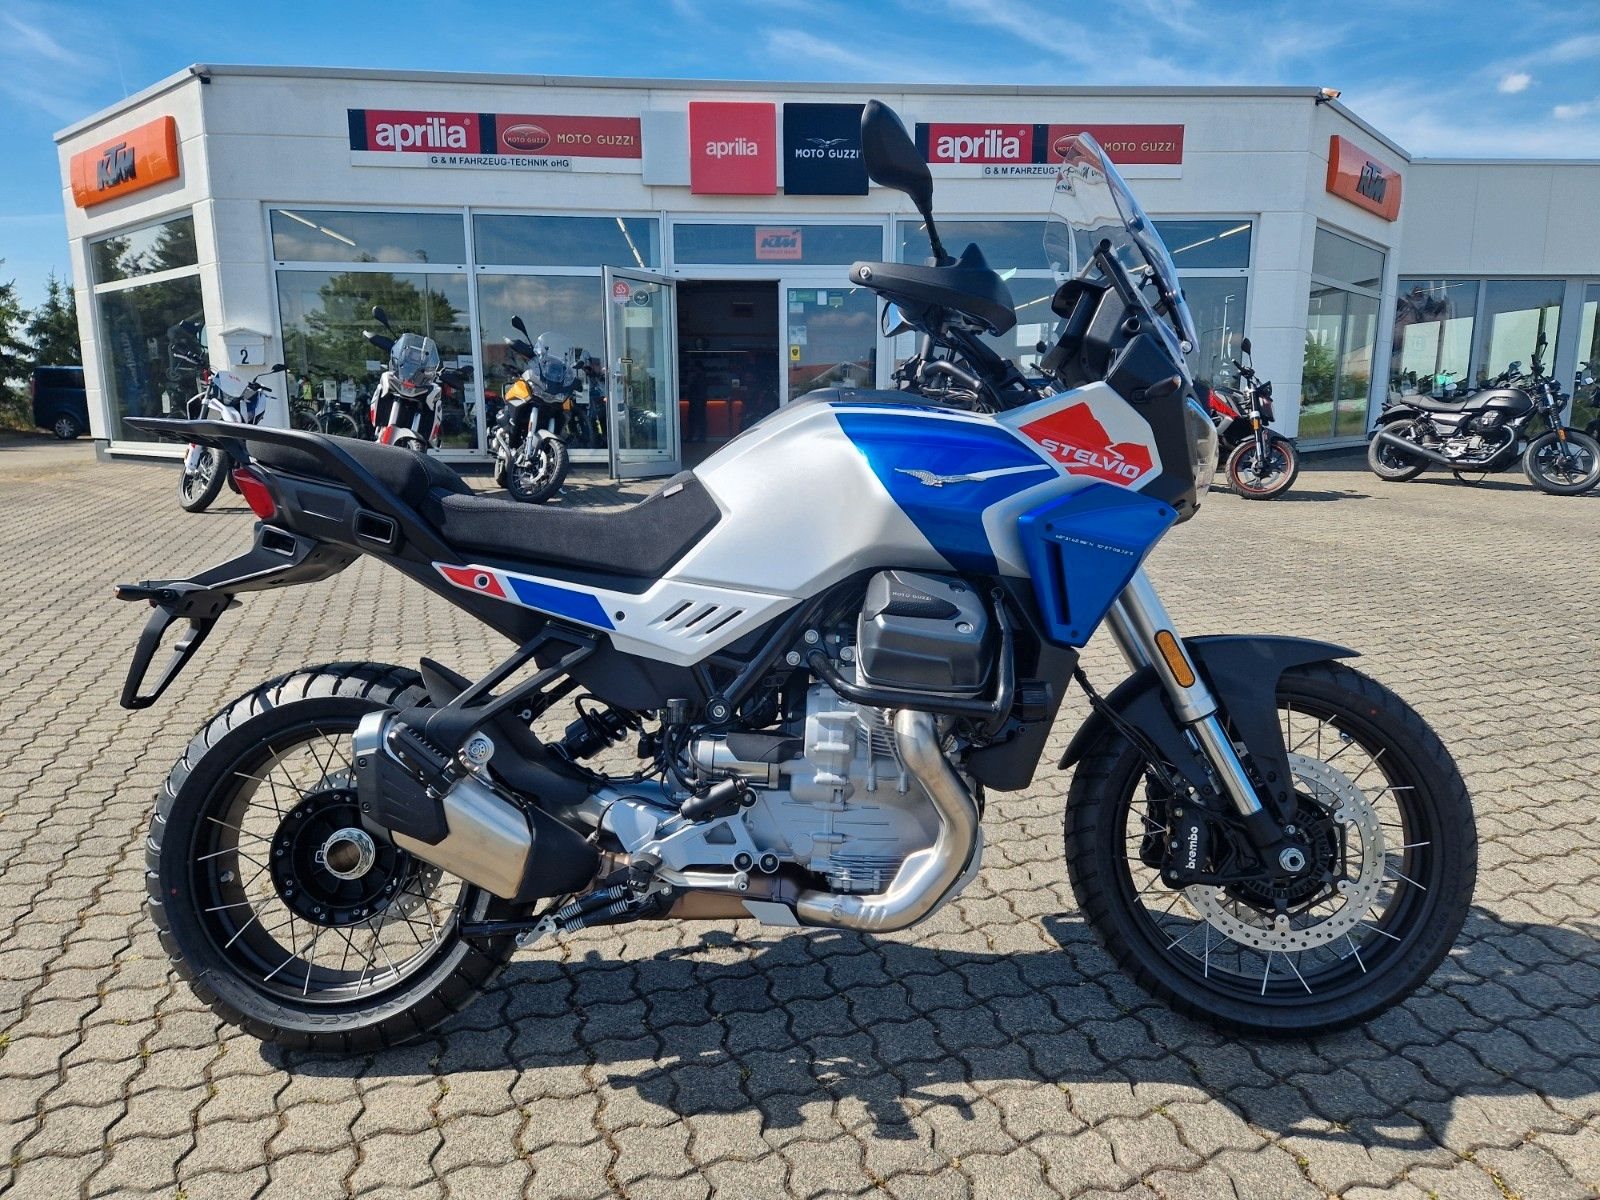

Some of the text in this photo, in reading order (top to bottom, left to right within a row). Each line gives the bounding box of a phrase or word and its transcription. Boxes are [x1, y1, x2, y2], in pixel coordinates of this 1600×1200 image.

[507, 135, 546, 144] MOTO GUZZI
[557, 134, 633, 145] MOTO GUZZI
[706, 138, 758, 159] aprilia
[1104, 142, 1175, 152] MOTO GUZZI
[795, 149, 859, 159] MOTO GUZZI
[97, 142, 136, 191] KTM
[431, 156, 569, 168] G & M FAHRZEUG-TECHNIK oHG
[984, 166, 991, 175] G
[993, 167, 1000, 175] &
[1001, 167, 1009, 175] M
[1356, 161, 1387, 204] KTM
[240, 349, 249, 364] 2
[1039, 438, 1140, 479] STELVIO
[1185, 826, 1199, 869] brembo
